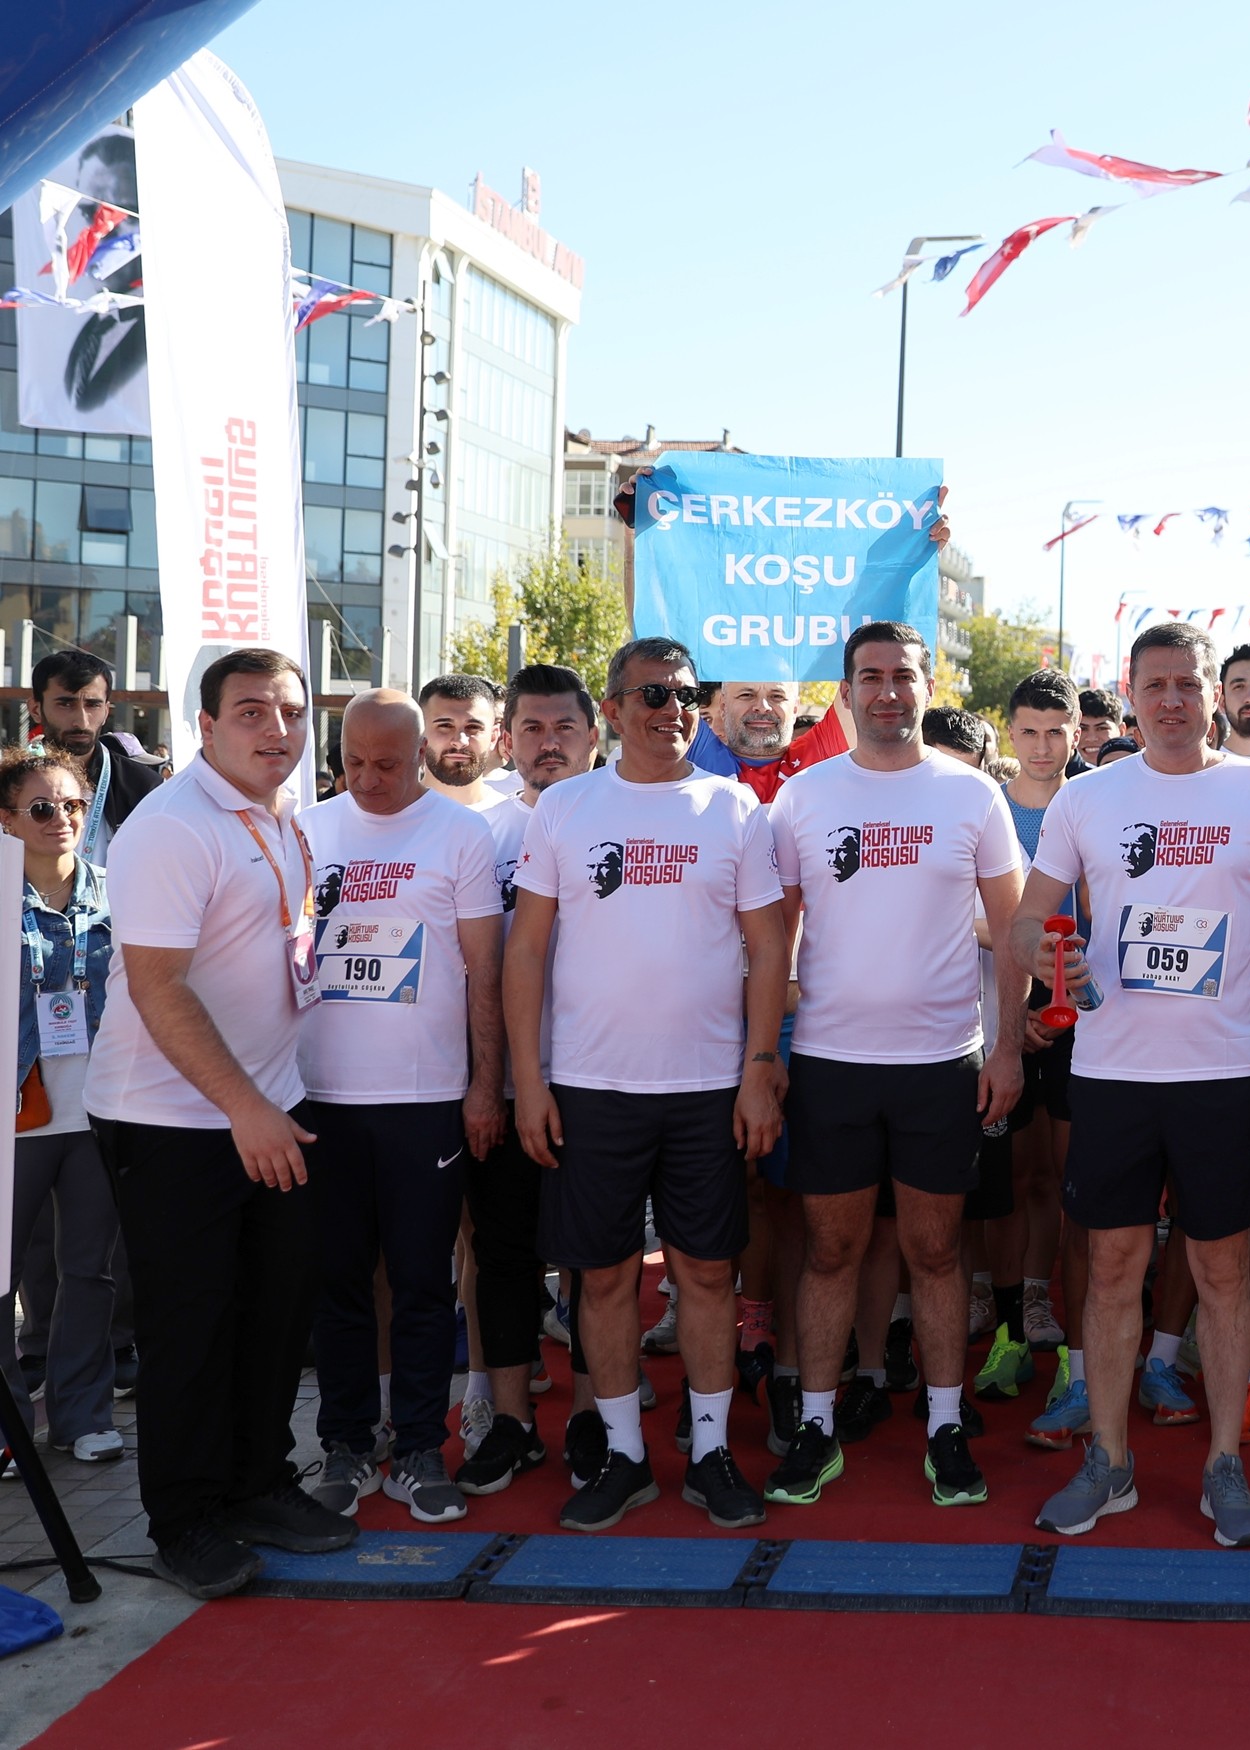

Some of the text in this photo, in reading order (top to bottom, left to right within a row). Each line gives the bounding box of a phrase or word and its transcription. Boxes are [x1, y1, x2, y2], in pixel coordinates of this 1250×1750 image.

[647, 491, 934, 531] ÇERKEZKÖY
[724, 553, 856, 594] KOŞU
[861, 825, 934, 848] KURTULUŞ
[1157, 826, 1231, 846] KURTULUŞ
[624, 845, 699, 865] KURTULUŞ
[861, 845, 919, 869] KOŞUSU
[1155, 846, 1215, 868] KOŞUSU
[344, 862, 417, 884] KURTULUŞ
[623, 864, 684, 886] KOŞUSU
[340, 880, 399, 903] KOŞUSU
[344, 957, 382, 982] 190
[1146, 946, 1189, 973] 059
